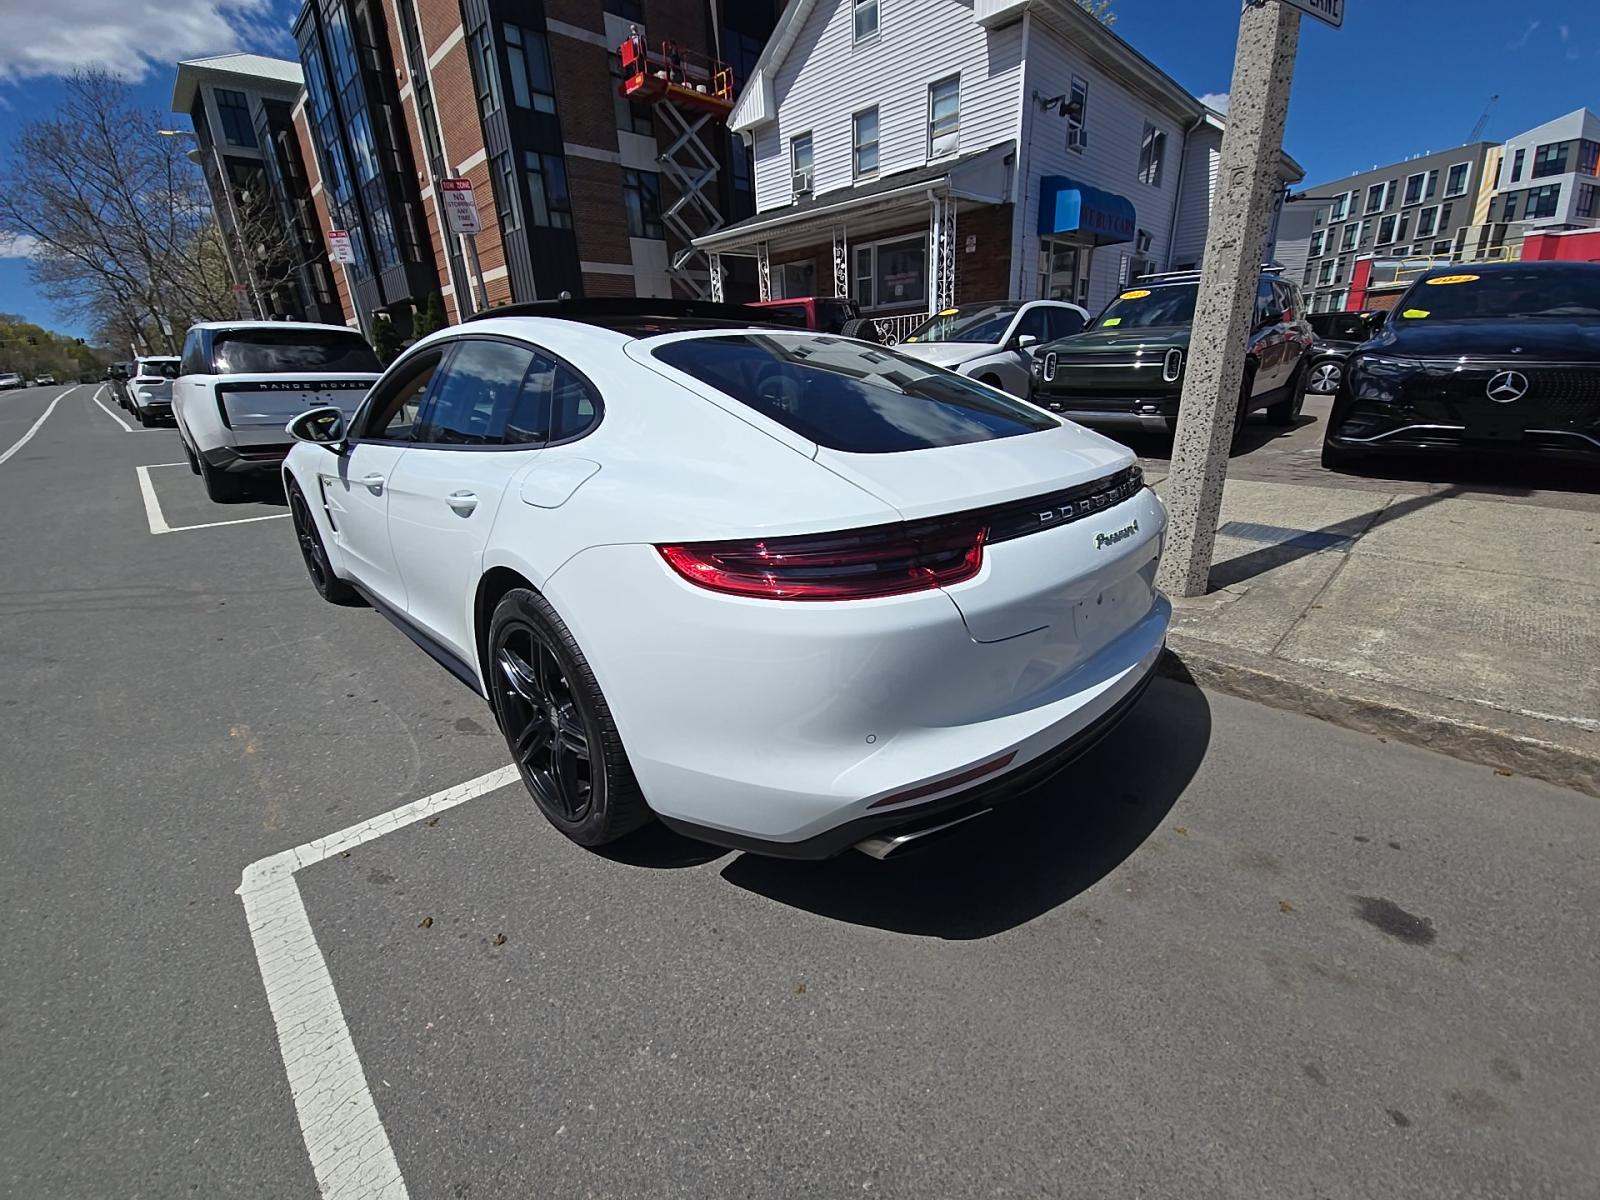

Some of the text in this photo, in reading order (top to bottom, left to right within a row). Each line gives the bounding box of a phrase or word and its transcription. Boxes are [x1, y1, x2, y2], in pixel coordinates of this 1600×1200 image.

[456, 181, 471, 189] ZONE
[453, 193, 465, 201] NO
[1038, 478, 1137, 525] PORSCHE
